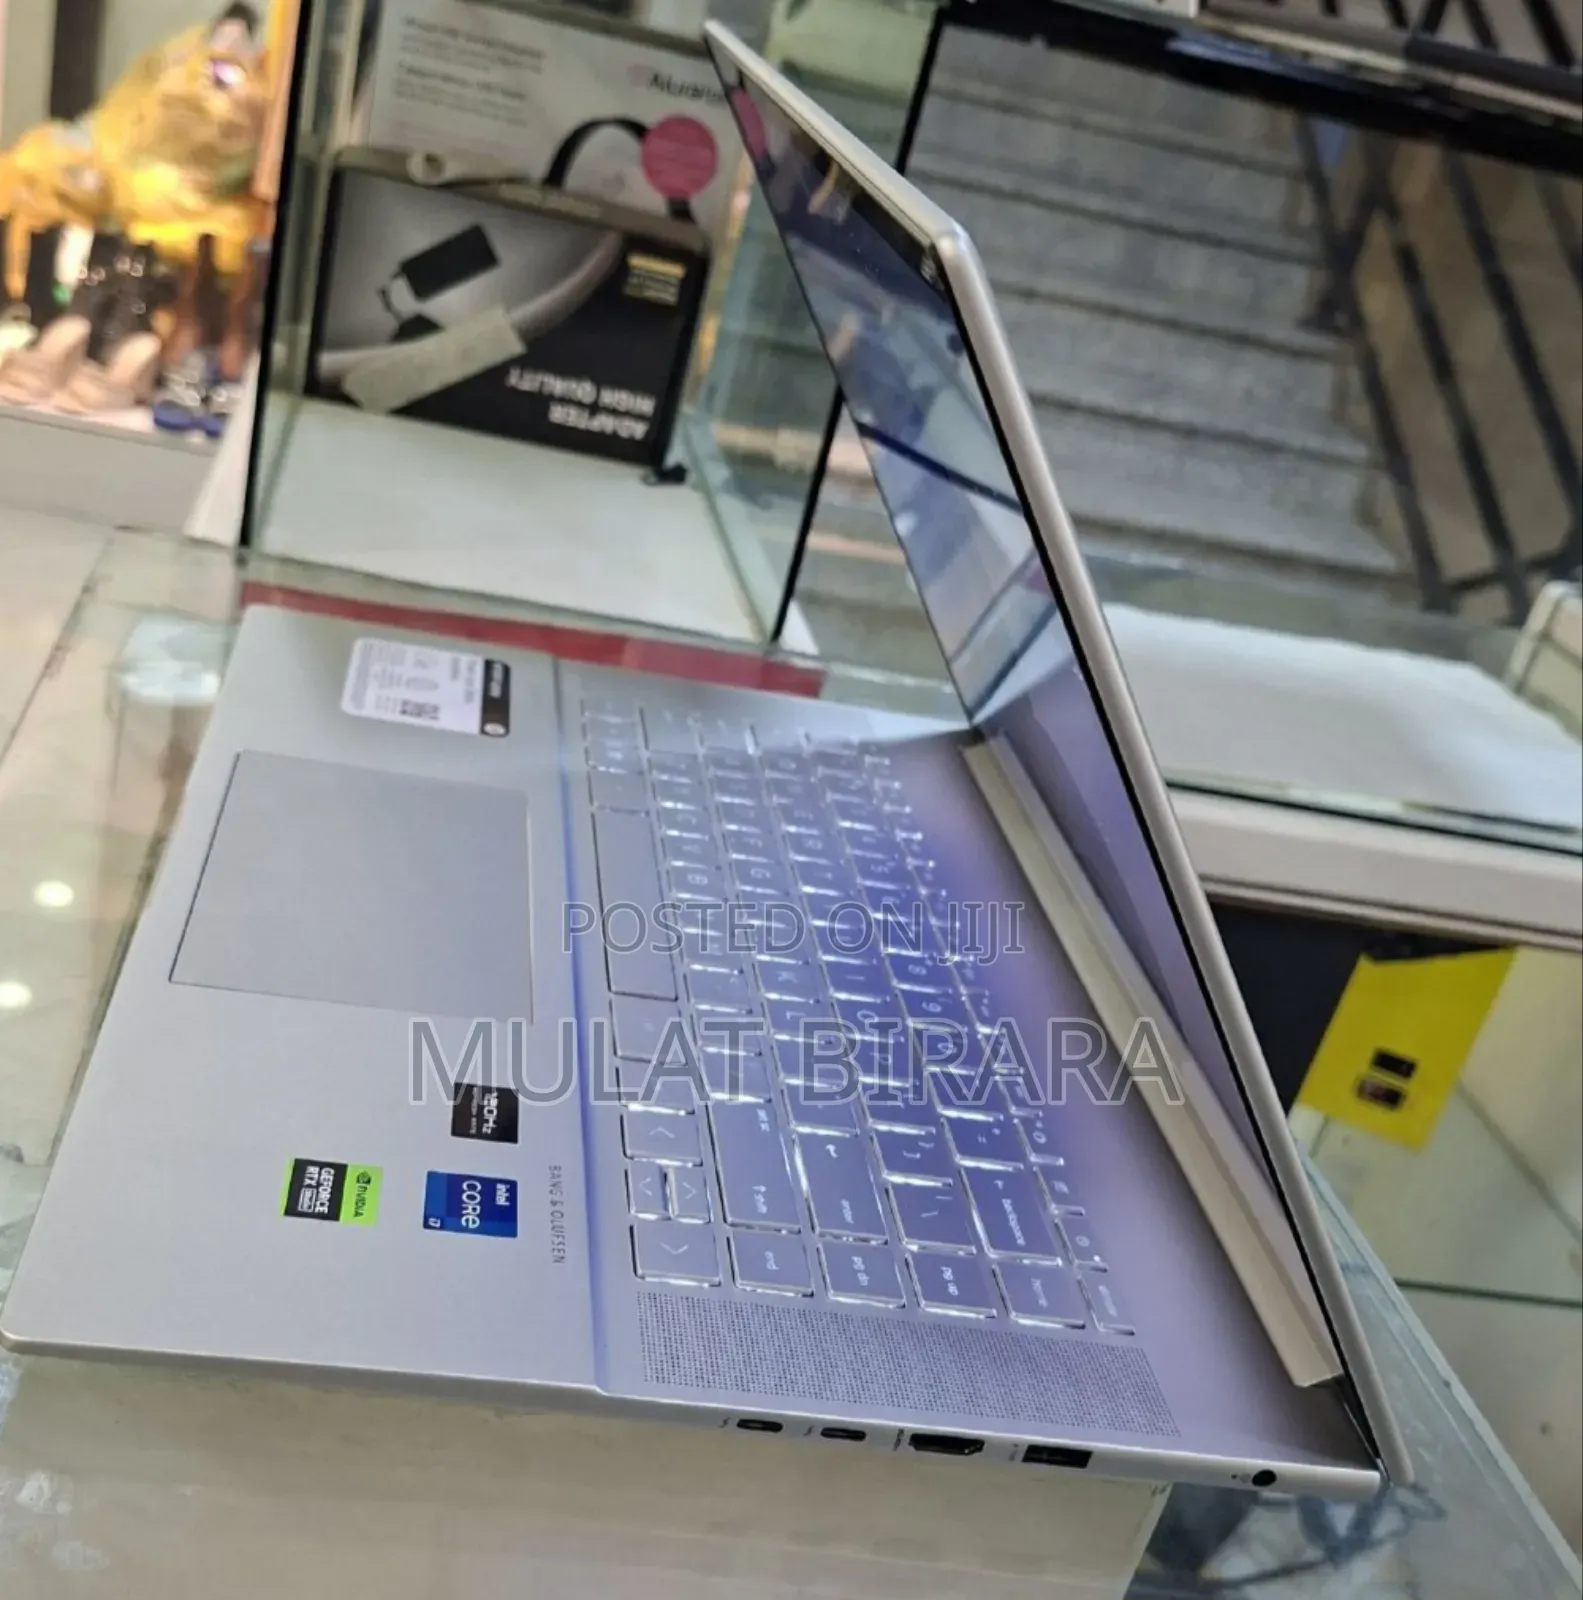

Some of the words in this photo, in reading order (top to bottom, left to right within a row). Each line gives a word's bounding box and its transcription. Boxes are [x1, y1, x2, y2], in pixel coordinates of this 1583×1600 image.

[548, 401, 649, 440] ADAPTER
[304, 1165, 320, 1187] RTX
[548, 1165, 564, 1197] BANG
[314, 1167, 335, 1215] GEFORCE
[495, 1183, 510, 1206] intel
[428, 1218, 441, 1229] i7
[840, 1199, 854, 1224] enter
[1001, 1198, 1026, 1246] backspace
[550, 1210, 566, 1264] OLUFSEN
[764, 1251, 779, 1270] end
[852, 1256, 866, 1272] pg
[940, 1266, 953, 1282] pg
